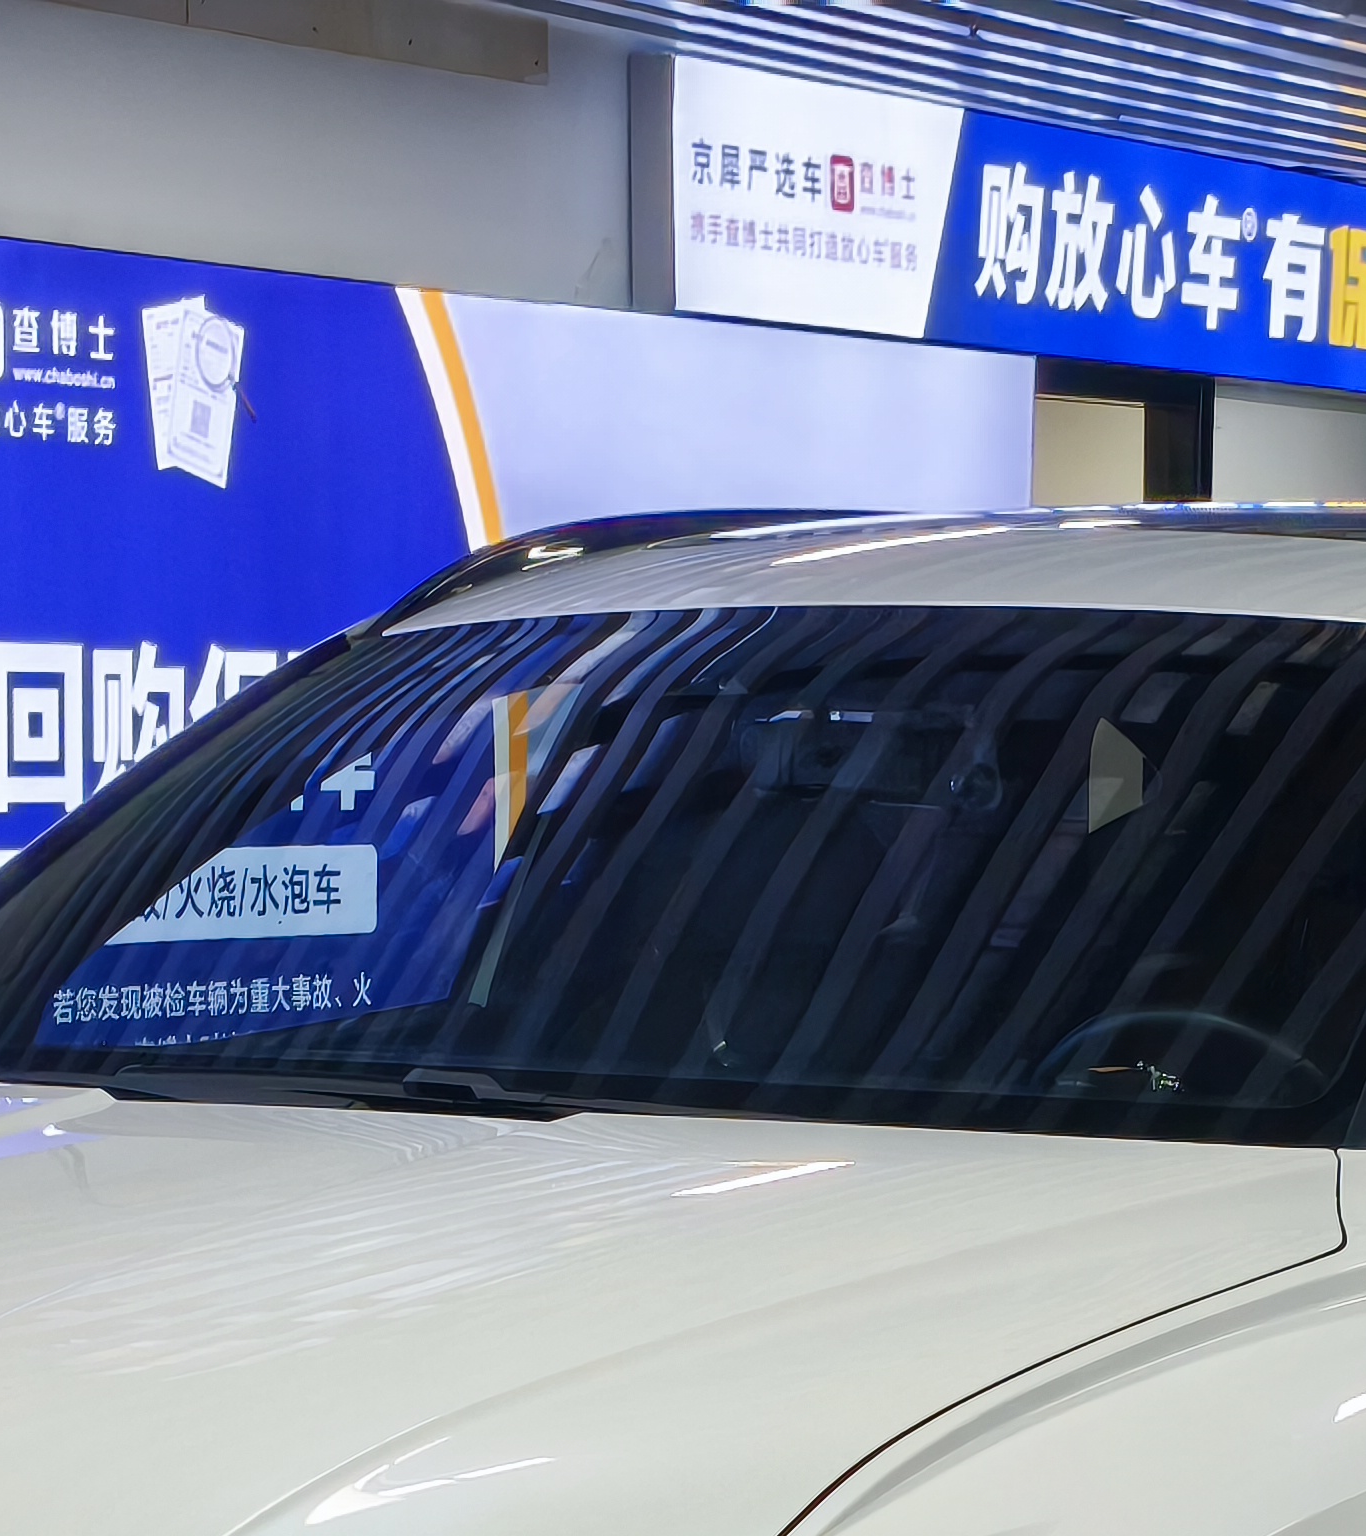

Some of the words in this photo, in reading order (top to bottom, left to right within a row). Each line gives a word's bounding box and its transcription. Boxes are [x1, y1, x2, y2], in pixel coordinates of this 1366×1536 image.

[691, 138, 822, 202] 京犀严选车
[12, 305, 116, 362] 查博士
